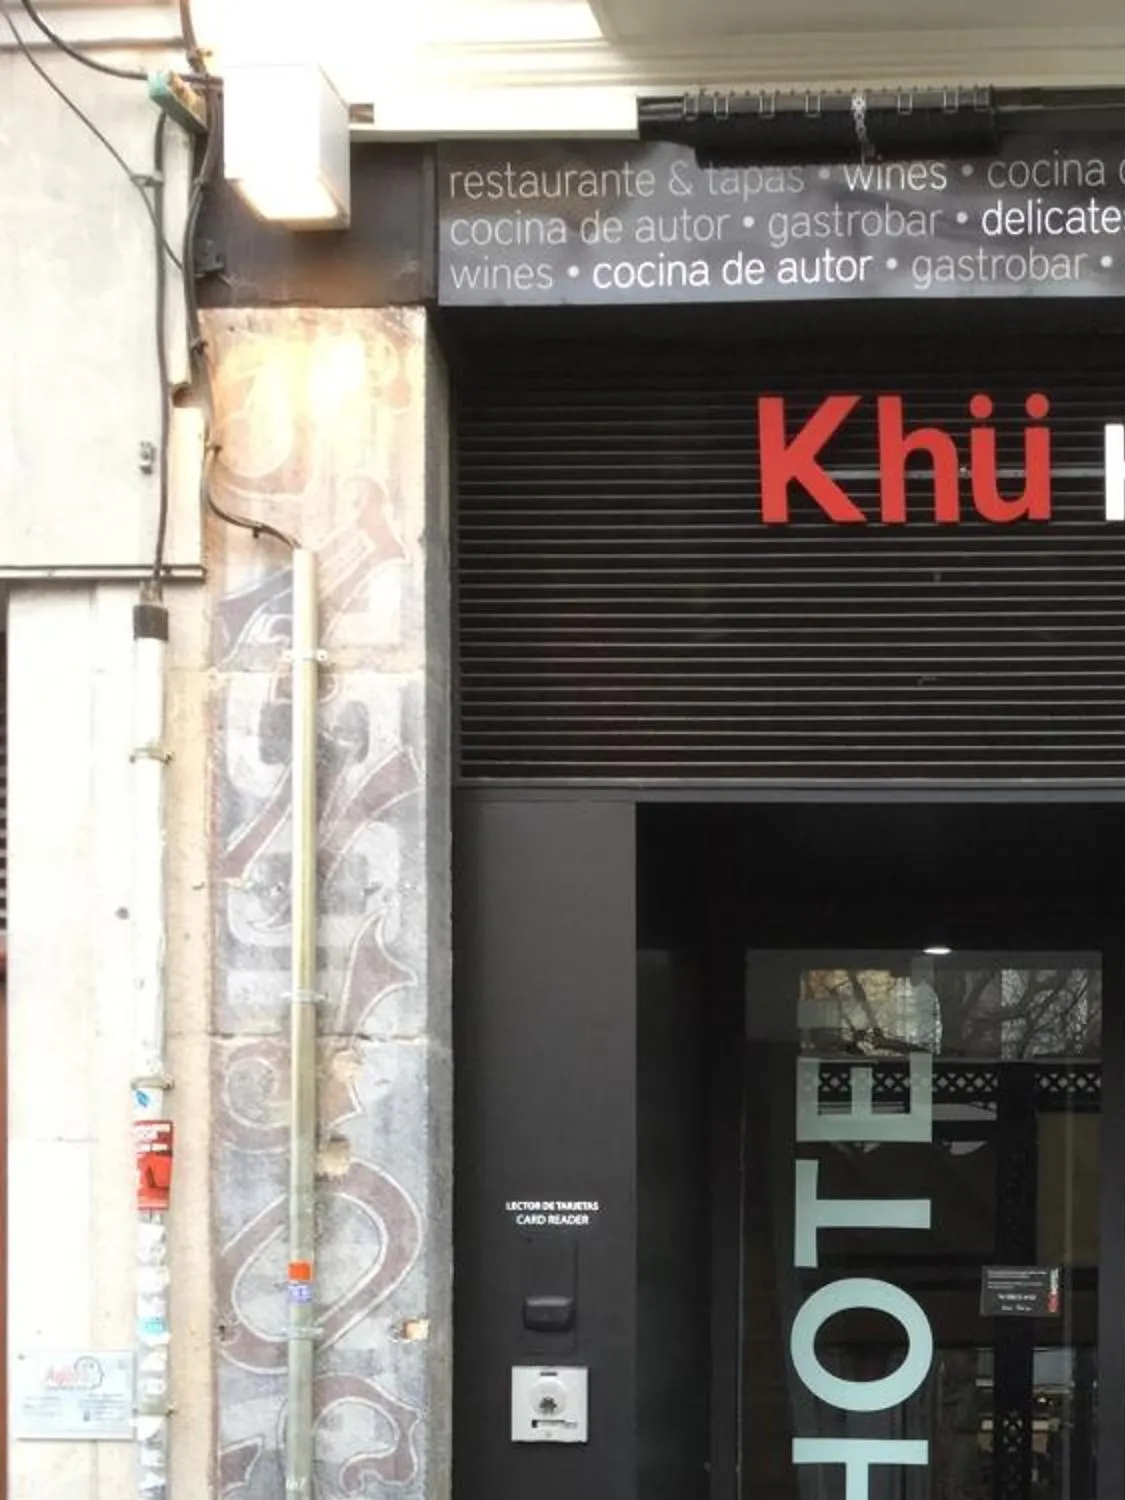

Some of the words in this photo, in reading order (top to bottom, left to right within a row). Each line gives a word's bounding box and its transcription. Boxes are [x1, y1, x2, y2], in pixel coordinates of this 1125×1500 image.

[450, 161, 656, 199] restaurante
[668, 159, 693, 196] &
[707, 160, 805, 202] tapas
[843, 154, 948, 191] wines
[987, 149, 1106, 188] cocina
[450, 209, 568, 246] cocina
[580, 208, 623, 244] de
[635, 208, 732, 243] autor
[768, 202, 943, 249] gastrobar
[450, 256, 553, 290] wines
[592, 252, 710, 289] cocina
[722, 249, 766, 286] de
[777, 247, 874, 284] autor
[911, 245, 1088, 291] gastrobar
[757, 393, 1051, 525] Khü
[505, 1201, 541, 1211] LECTOR
[542, 1201, 555, 1211] DE
[556, 1201, 599, 1211] TARJETAS
[515, 1214, 547, 1225] CARD
[547, 1214, 589, 1225] READER
